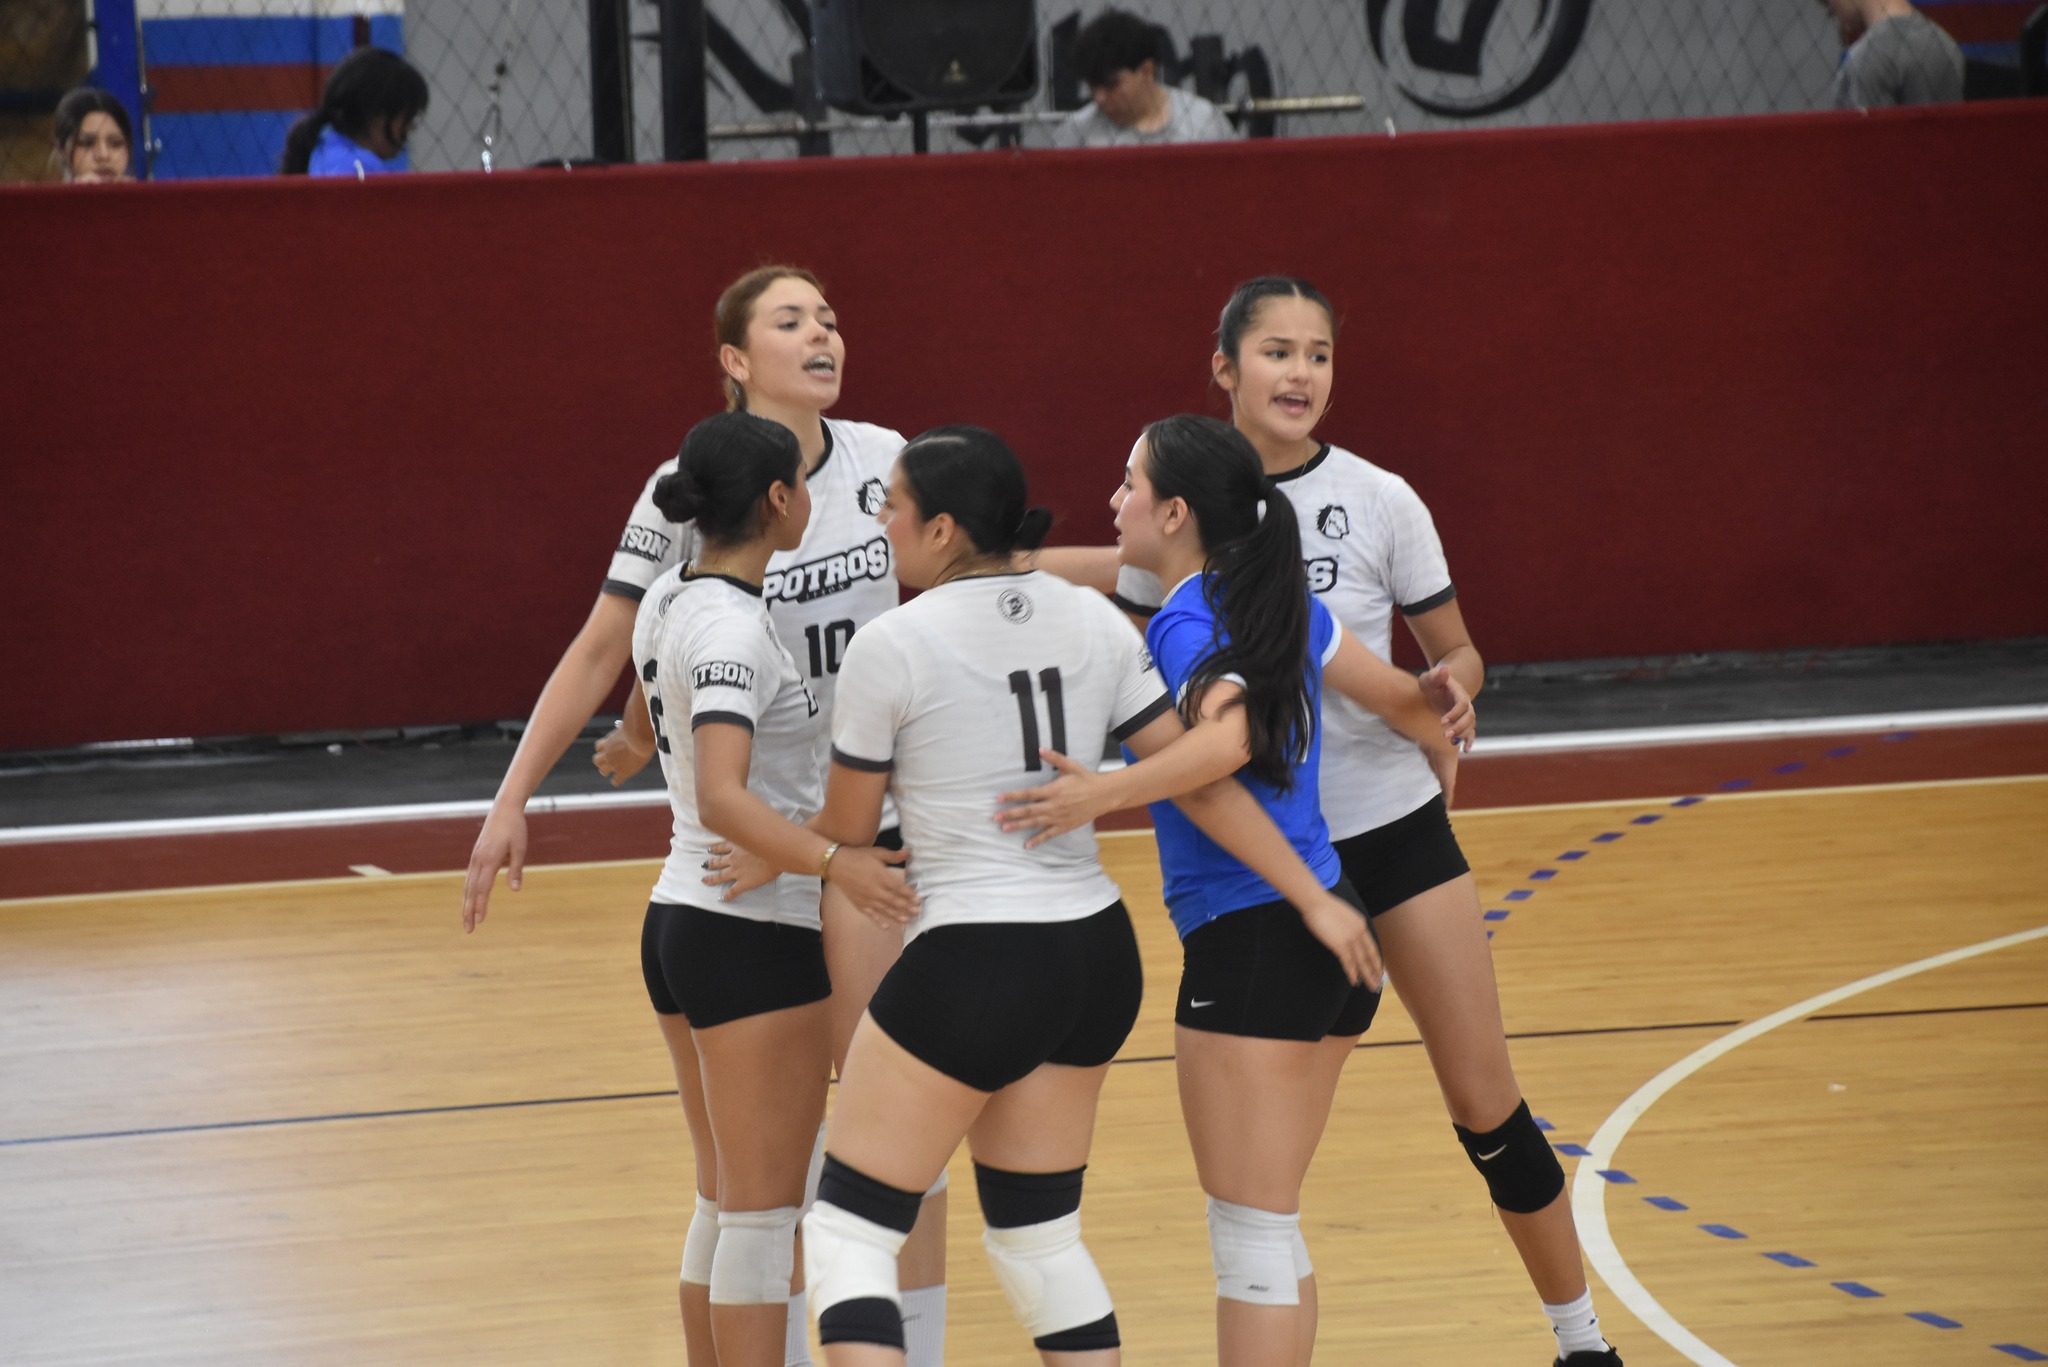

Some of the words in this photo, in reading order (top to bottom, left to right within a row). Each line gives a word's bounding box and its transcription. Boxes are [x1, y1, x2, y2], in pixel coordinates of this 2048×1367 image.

[763, 535, 889, 603] POTROS
[691, 660, 754, 692] ITSON
[804, 617, 856, 678] 10
[1008, 665, 1067, 772] 11
